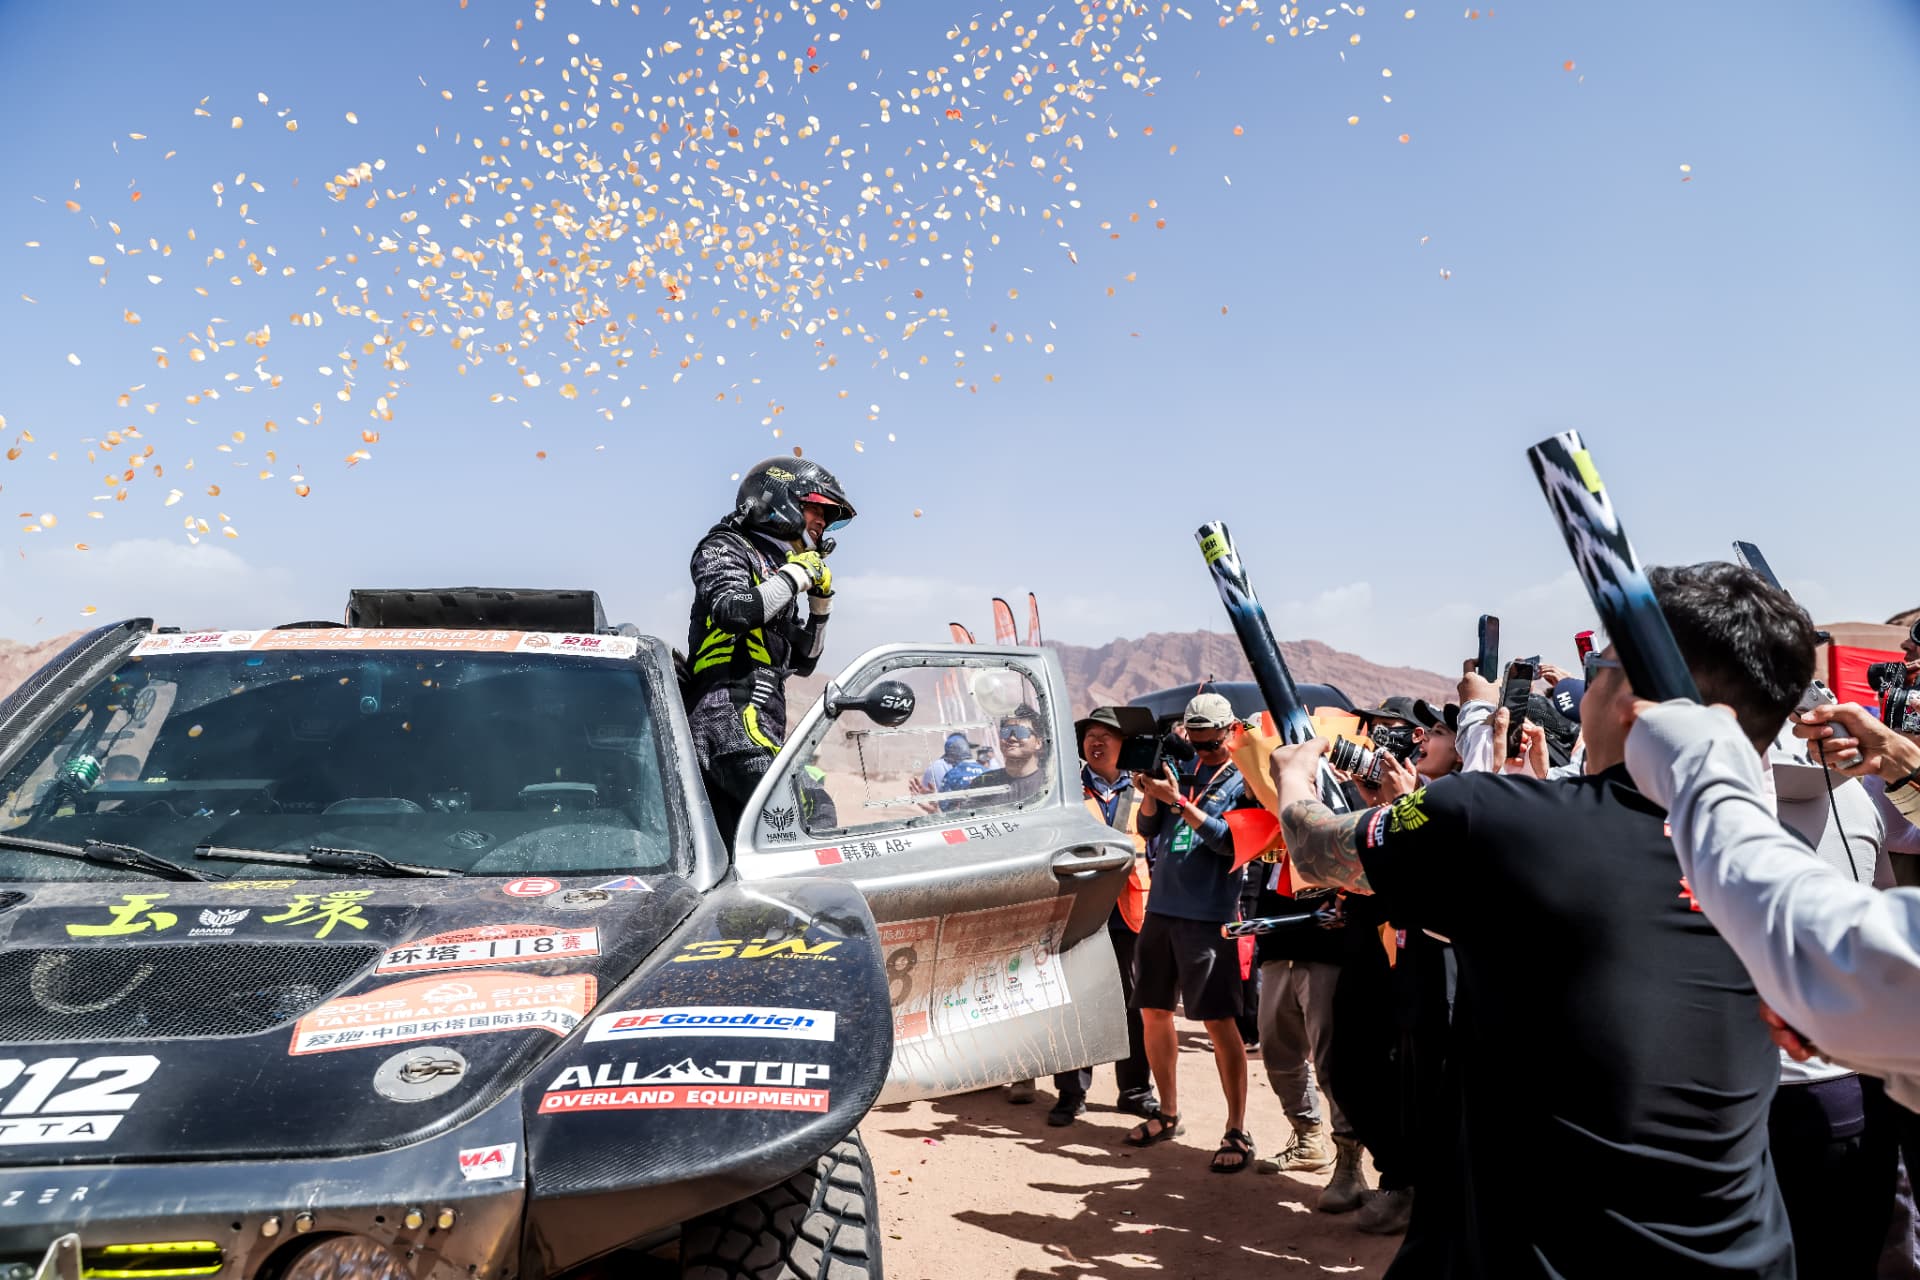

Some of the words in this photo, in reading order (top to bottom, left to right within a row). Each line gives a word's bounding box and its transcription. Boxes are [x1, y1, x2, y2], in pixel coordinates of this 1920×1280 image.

[1556, 691, 1574, 712] HH
[766, 831, 797, 840] HANWEI
[968, 823, 1002, 841] 马利
[1002, 821, 1021, 833] B+
[841, 843, 881, 862] 韩魏
[886, 839, 913, 854] AB+
[522, 880, 546, 893] E
[880, 925, 929, 941] 际拉力赛
[771, 951, 838, 962] Auto-life
[316, 999, 408, 1016] 2005
[491, 982, 577, 998] 2026
[317, 1001, 487, 1028] TAKLIMAKAN
[494, 993, 577, 1009] RALLY
[612, 1013, 816, 1029] BFGoodrich
[545, 1090, 675, 1108] OVERLAND
[686, 1090, 825, 1107] EQUIPMENT
[1, 1186, 89, 1207] ZER
